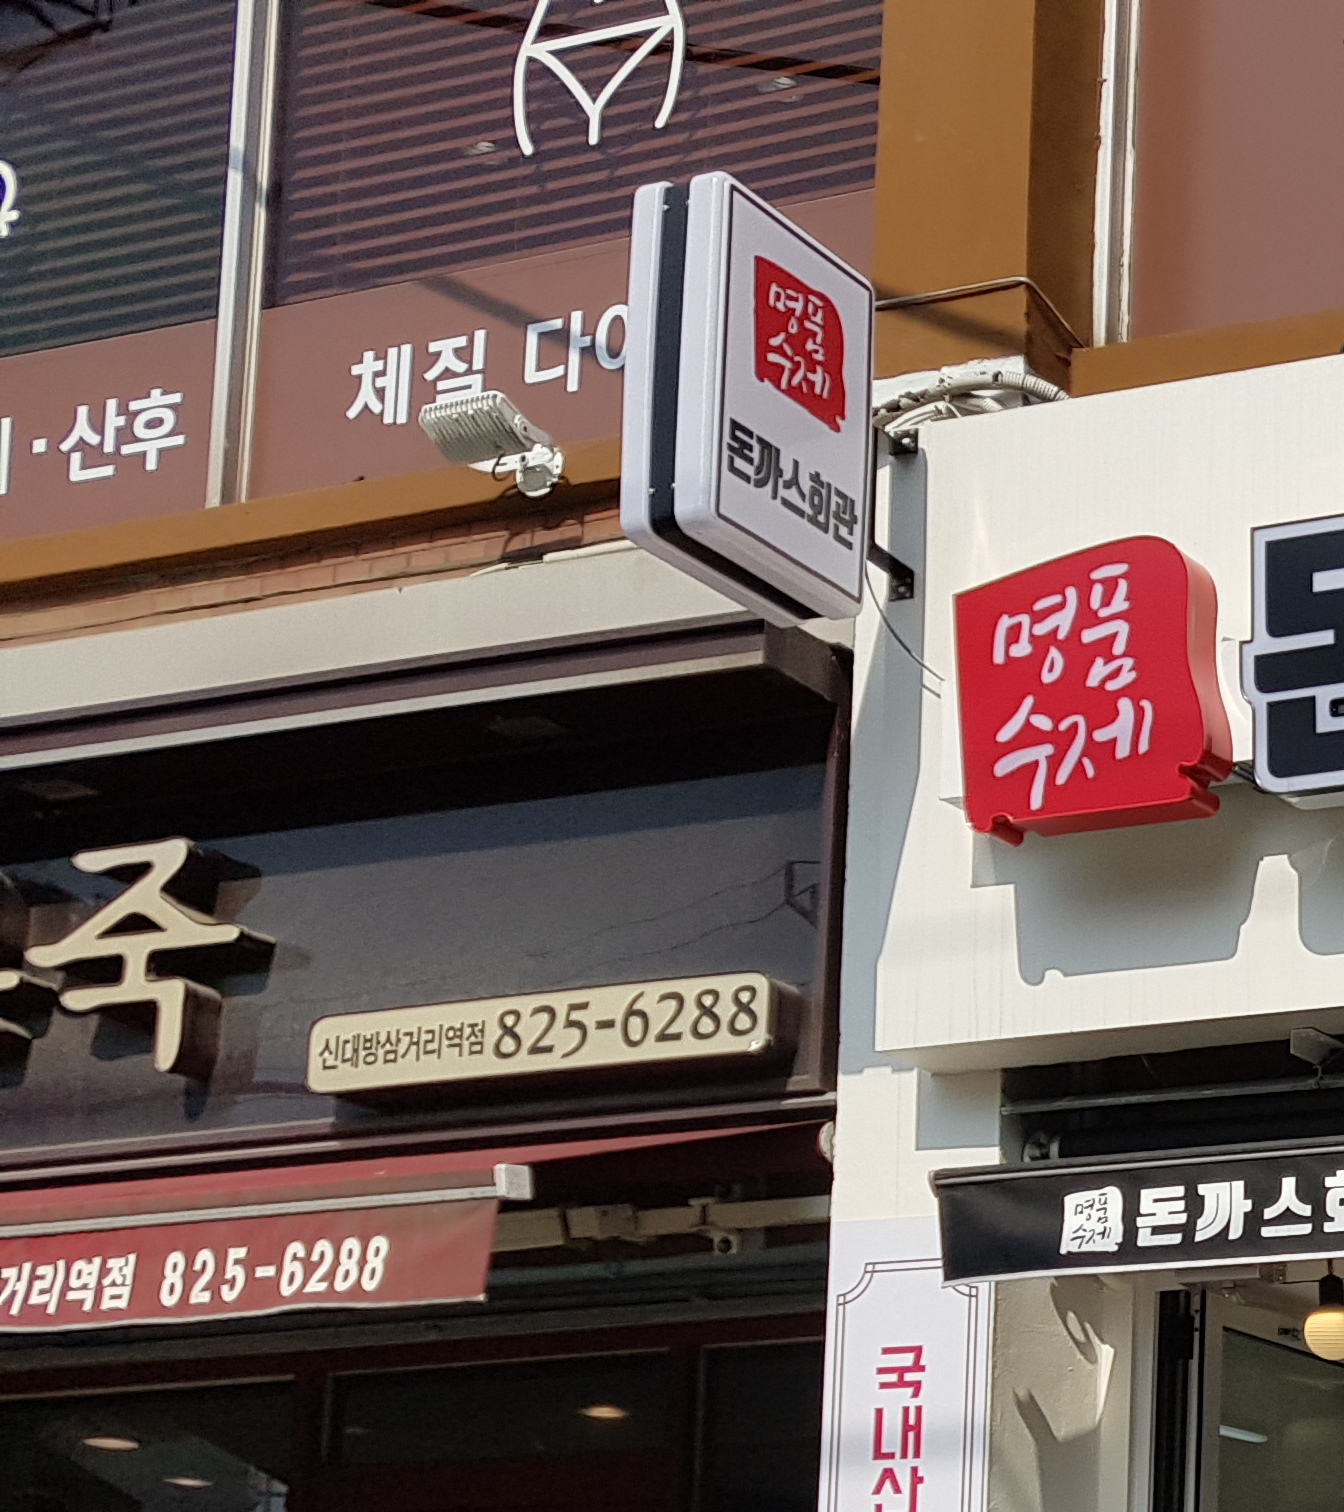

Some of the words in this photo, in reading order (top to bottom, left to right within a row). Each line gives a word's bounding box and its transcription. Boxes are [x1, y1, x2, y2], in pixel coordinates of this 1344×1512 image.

[767, 280, 828, 361] 명품
[346, 330, 489, 425] 체질
[766, 331, 833, 402] 수제
[726, 416, 860, 552] 돈까스회관
[993, 562, 1133, 692] 명품
[993, 694, 1155, 810] 수제
[318, 1019, 488, 1073] 신대방삼거리역점
[491, 984, 761, 1062] 825-6288
[1069, 1222, 1114, 1249] 수제
[1072, 1191, 1112, 1222] 명품
[158, 1235, 391, 1308] 825-6288
